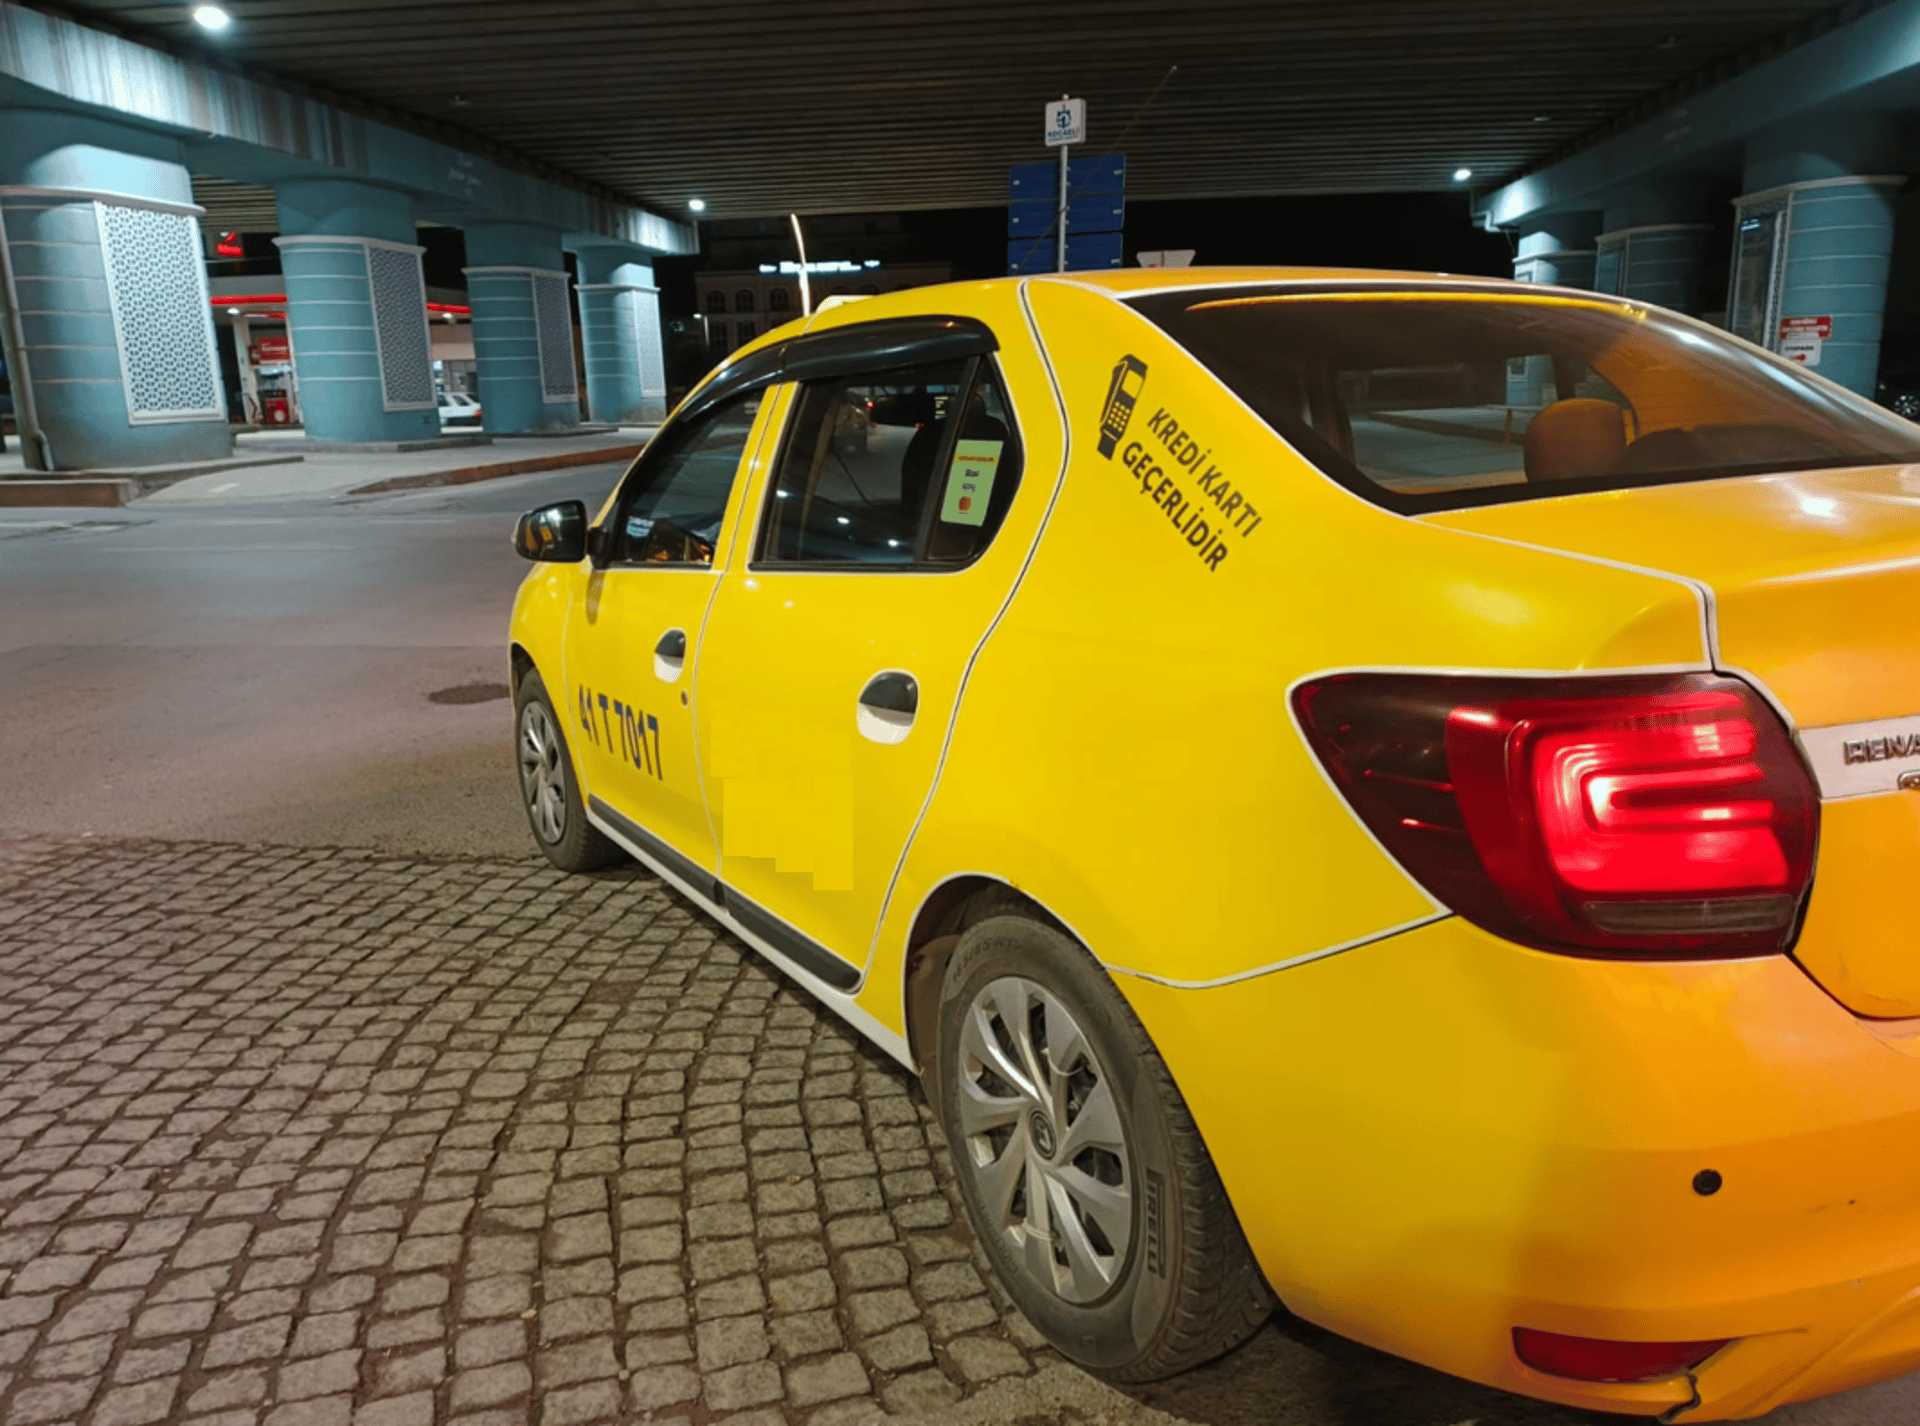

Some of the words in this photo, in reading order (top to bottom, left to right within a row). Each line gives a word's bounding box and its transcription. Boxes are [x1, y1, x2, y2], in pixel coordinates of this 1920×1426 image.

[1122, 441, 1228, 573] GEÇERLİDİR
[1147, 407, 1212, 475] KREDİ
[1197, 465, 1262, 538] KARTI
[579, 684, 600, 747] 41
[597, 692, 614, 755] T
[613, 698, 663, 781] 7017
[1146, 1167, 1166, 1279] PIRELLI
